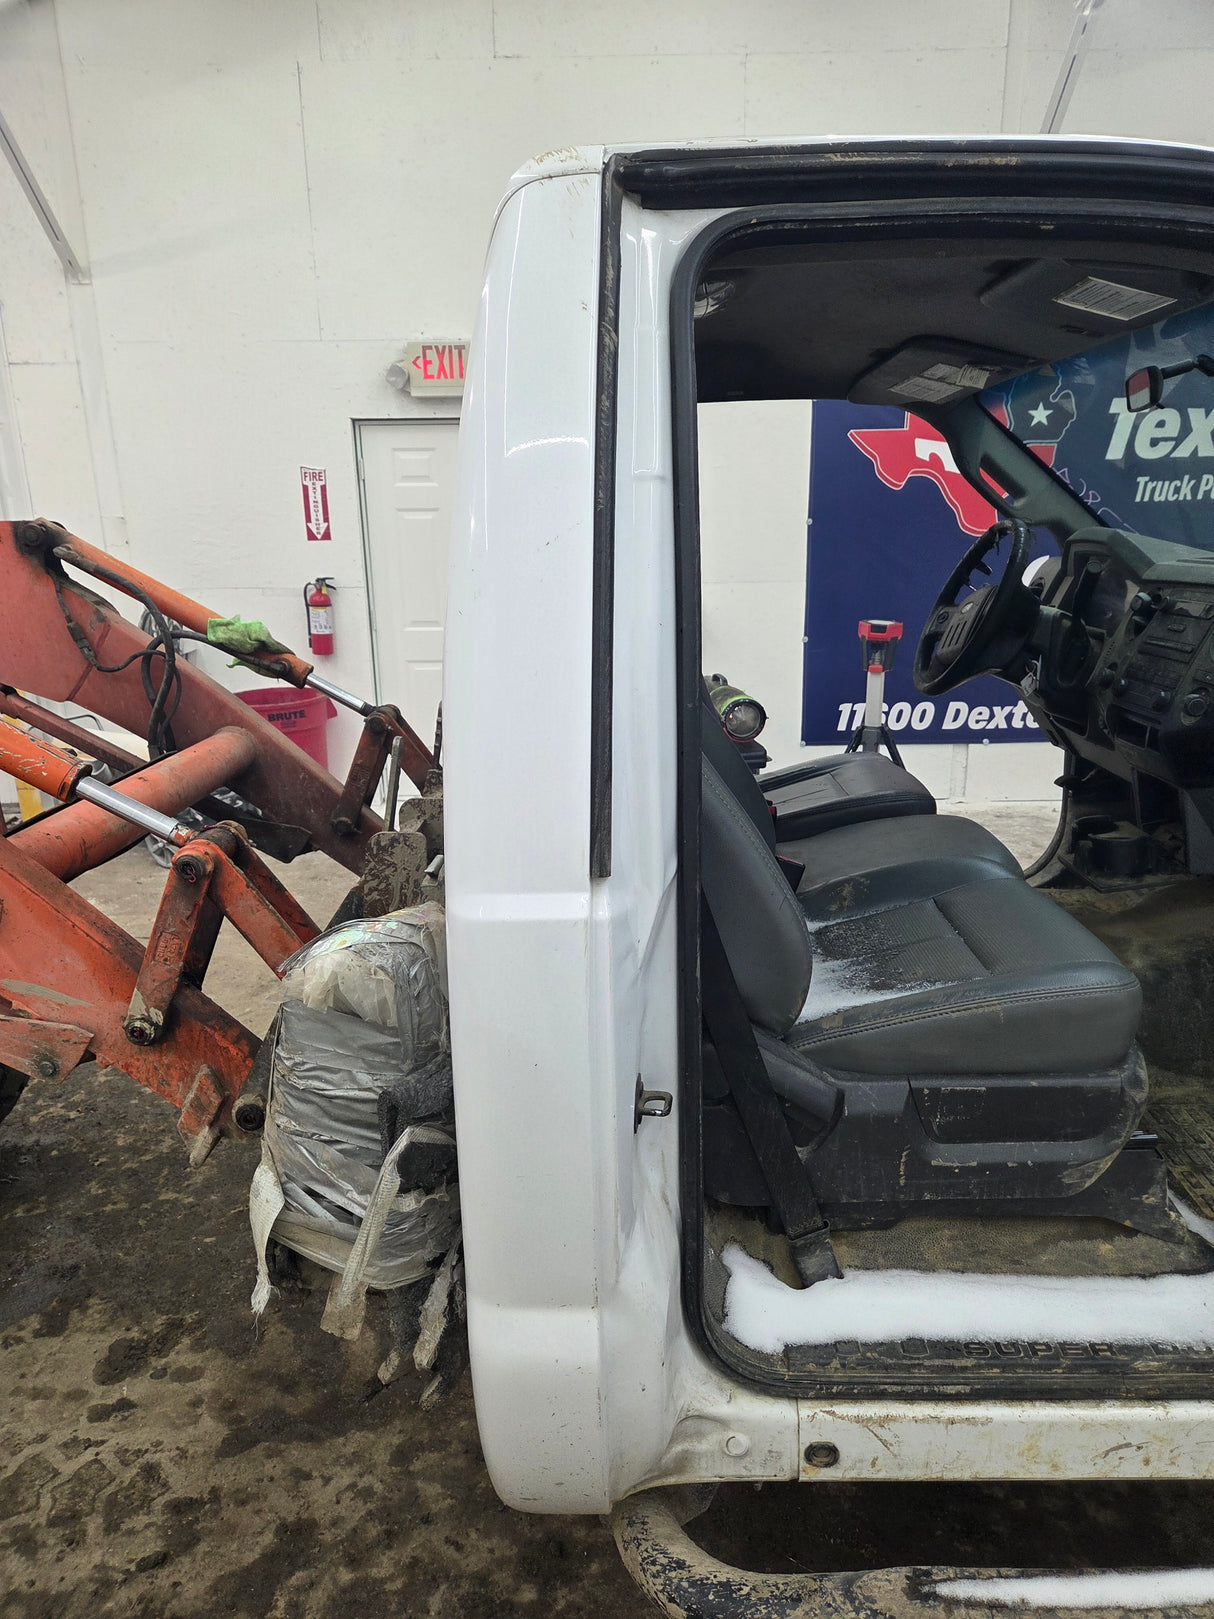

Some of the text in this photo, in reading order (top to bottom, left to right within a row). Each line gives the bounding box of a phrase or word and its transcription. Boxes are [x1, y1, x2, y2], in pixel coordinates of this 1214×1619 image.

[421, 345, 466, 379] EXIT
[303, 471, 323, 481] FIRE
[1134, 474, 1196, 502] Truck
[312, 481, 321, 535] EXTINGUISHER
[267, 709, 307, 722] BRUTE
[962, 1340, 1119, 1358] SUPER
